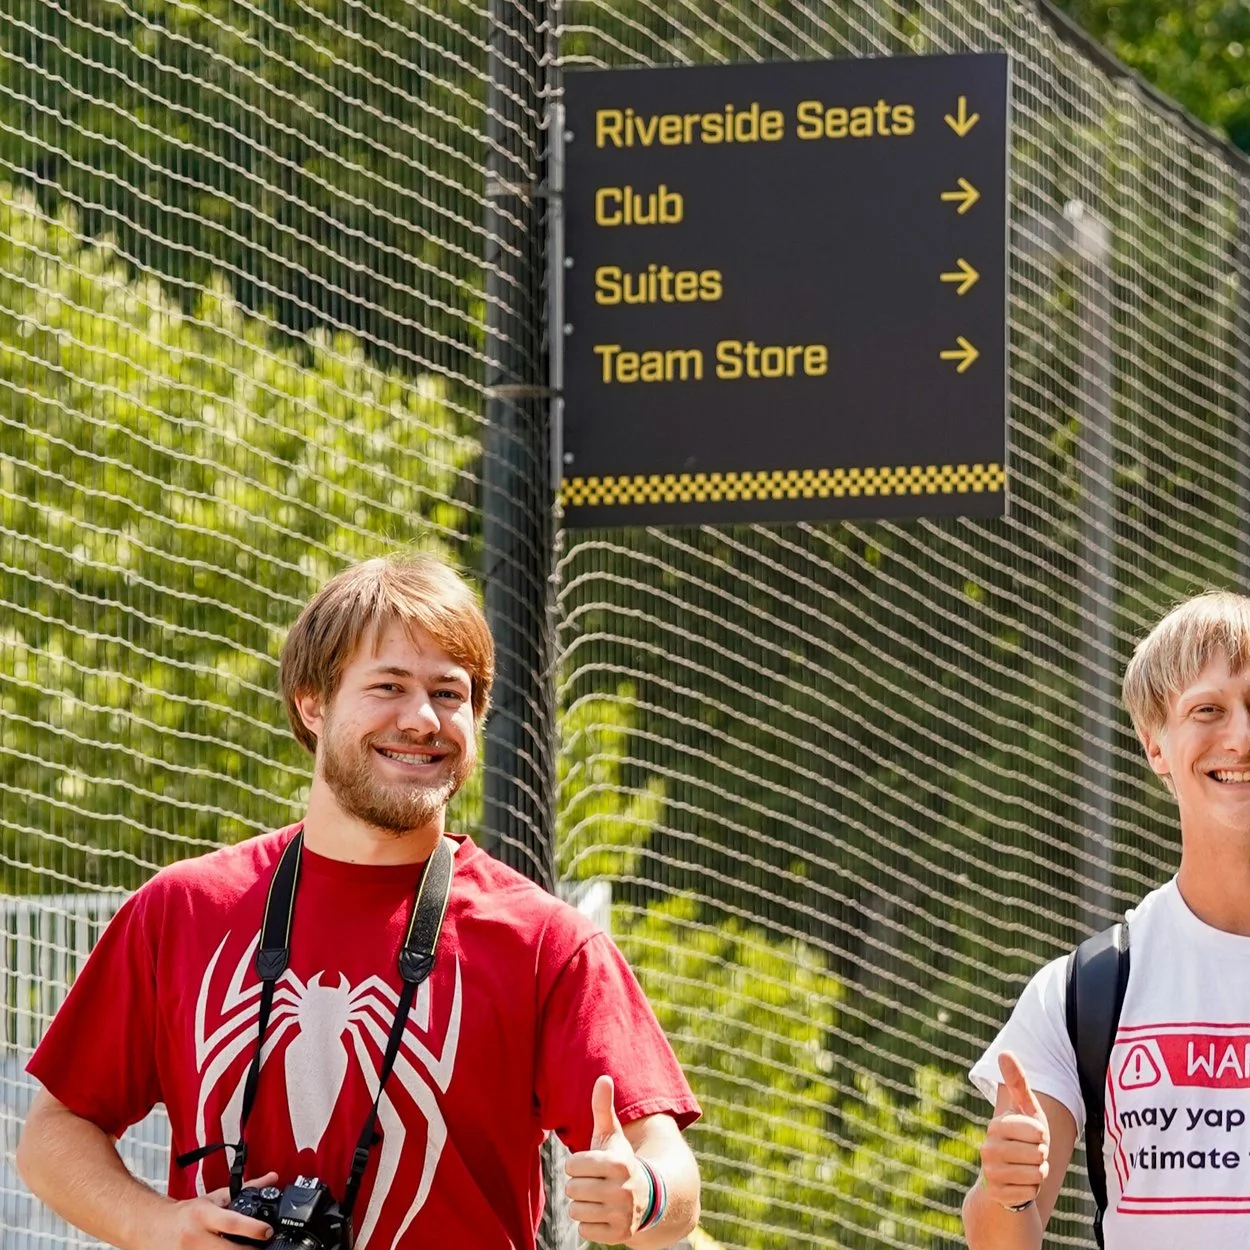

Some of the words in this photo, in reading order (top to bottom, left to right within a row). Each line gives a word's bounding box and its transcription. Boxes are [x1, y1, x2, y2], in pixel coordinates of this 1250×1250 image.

[595, 103, 785, 148] Riverside
[796, 99, 916, 140] Seats
[595, 184, 684, 226] Club
[595, 264, 723, 304] Suites
[593, 344, 703, 383] Team
[715, 339, 828, 379] Store
[1119, 1106, 1178, 1132] may
[1186, 1108, 1245, 1132] yap
[281, 1218, 304, 1228] Nikon
